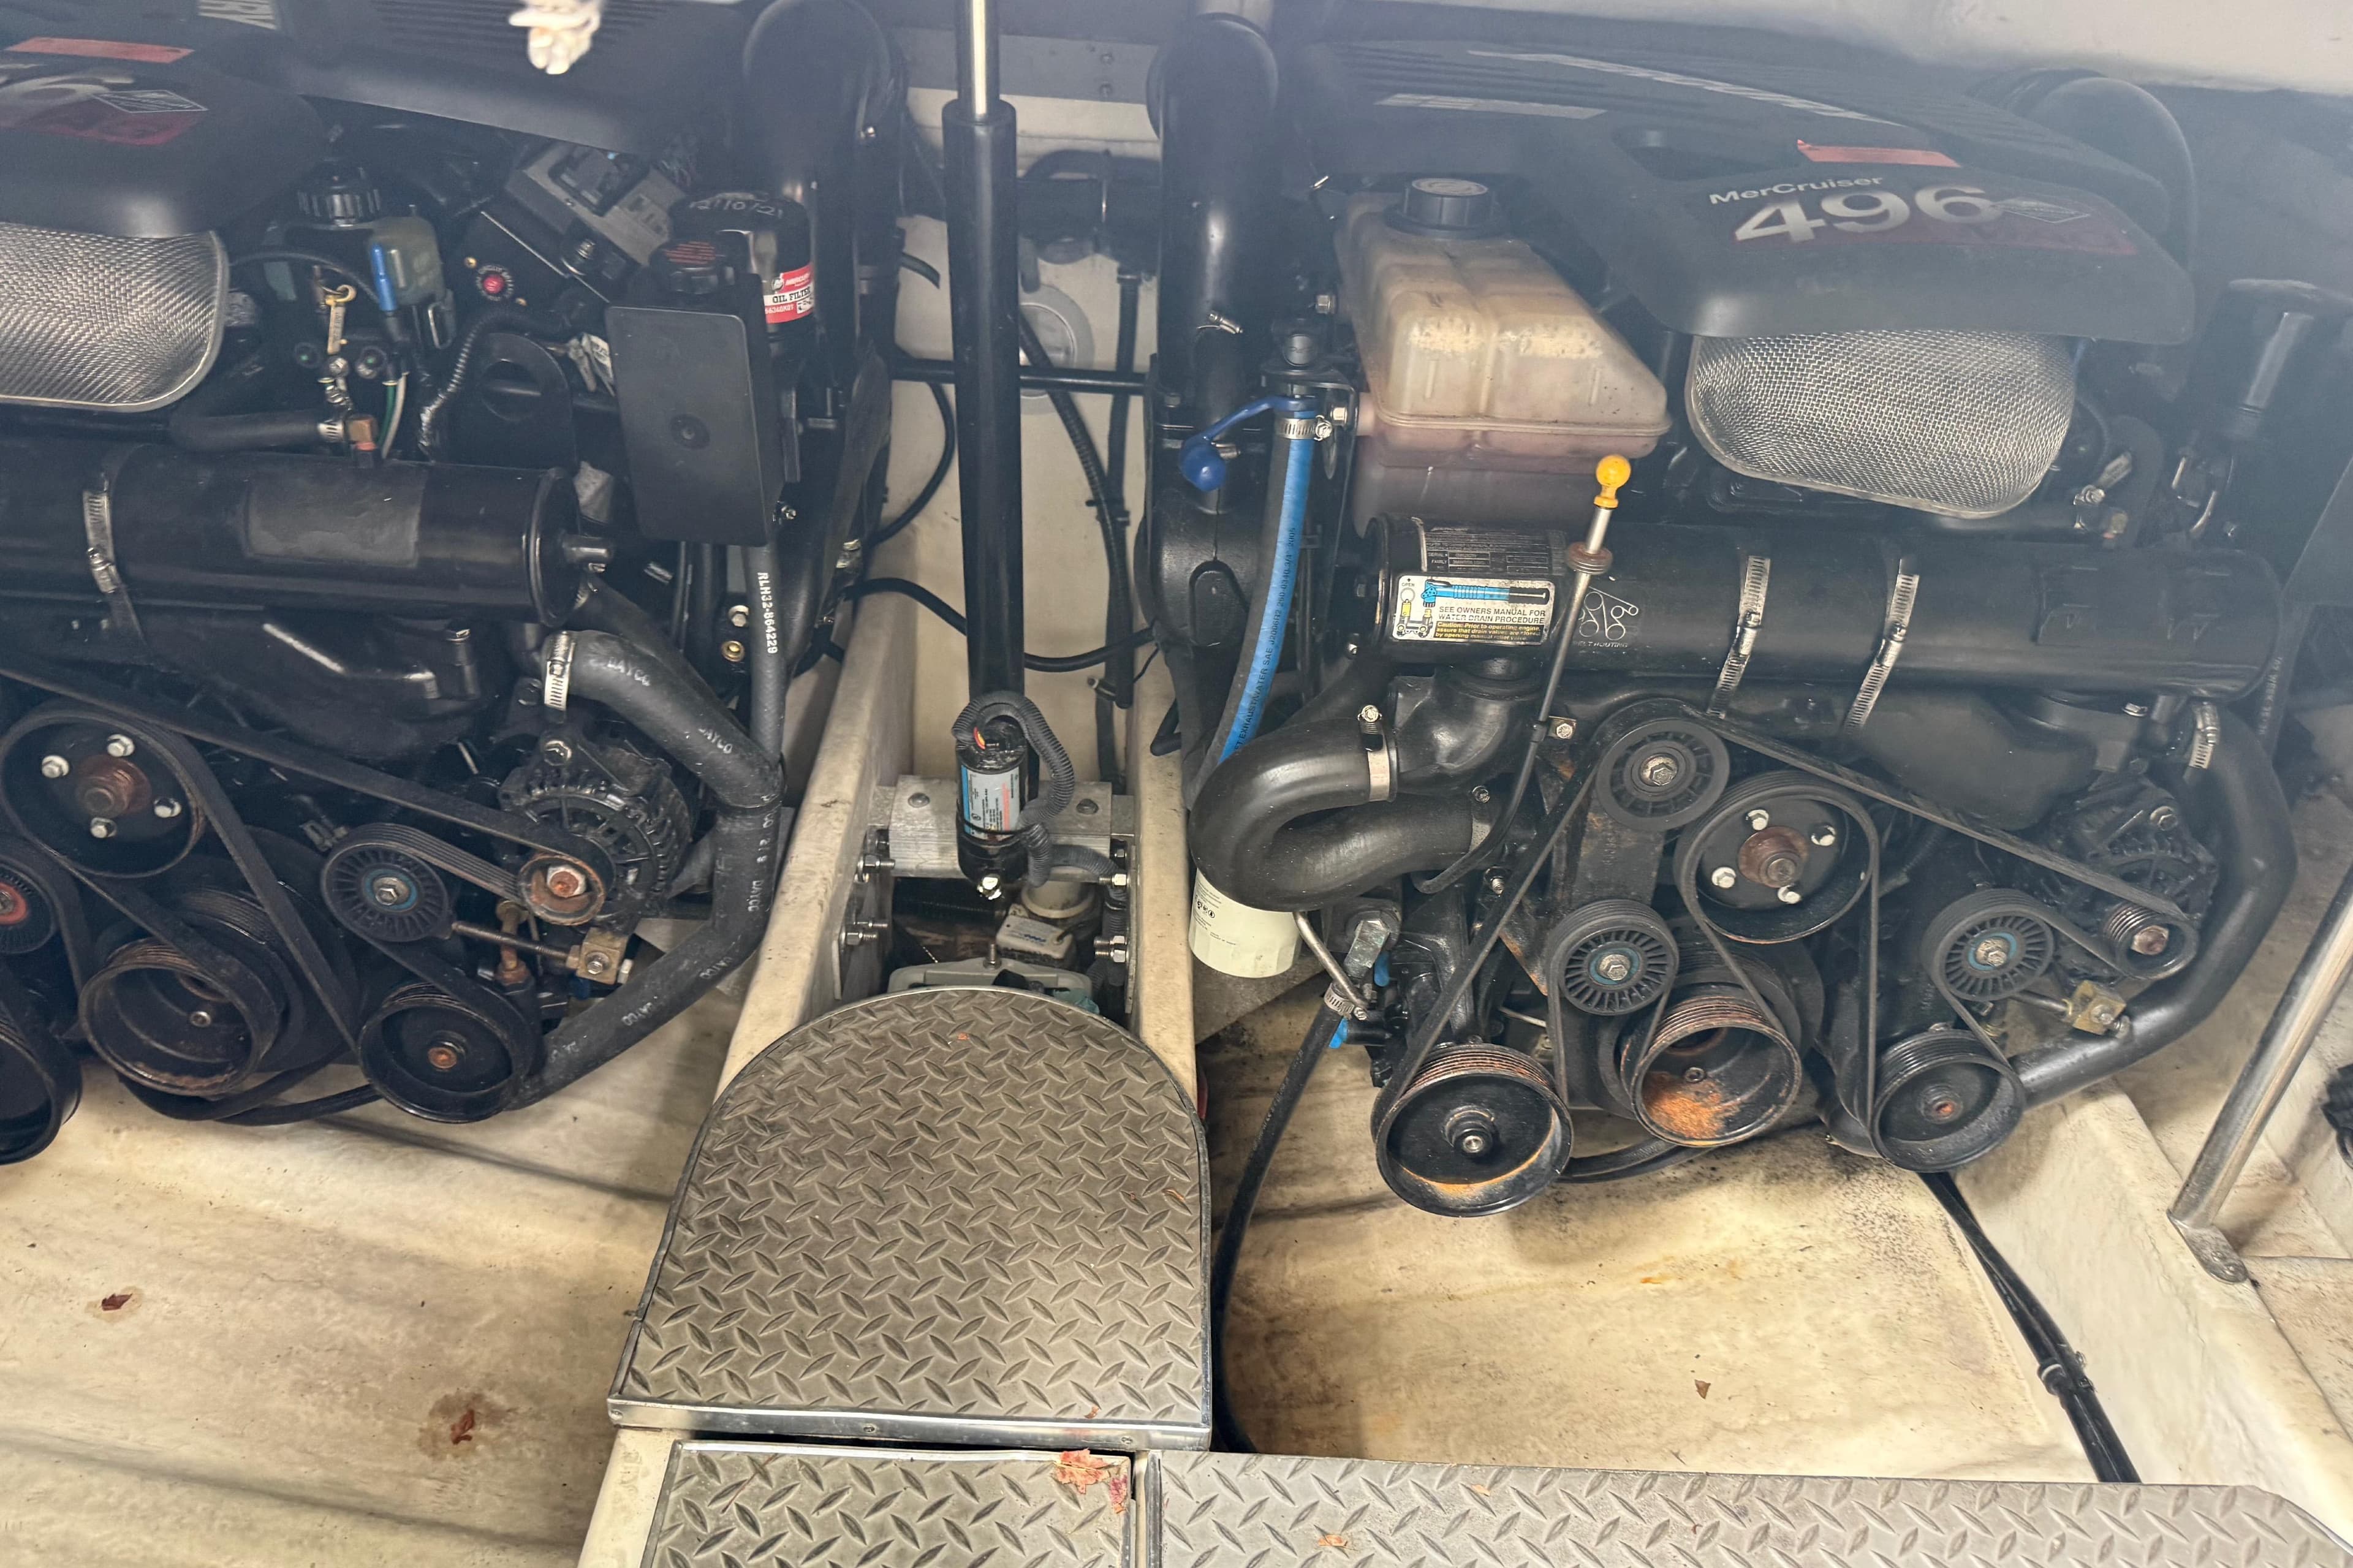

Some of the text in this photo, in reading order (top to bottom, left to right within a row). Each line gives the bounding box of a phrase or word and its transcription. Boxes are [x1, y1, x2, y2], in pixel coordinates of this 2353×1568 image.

[1709, 177, 1883, 205] MerCruiser
[1735, 185, 2003, 243] 496
[757, 572, 778, 654] RLH32-864229
[1263, 648, 1273, 665] SAE
